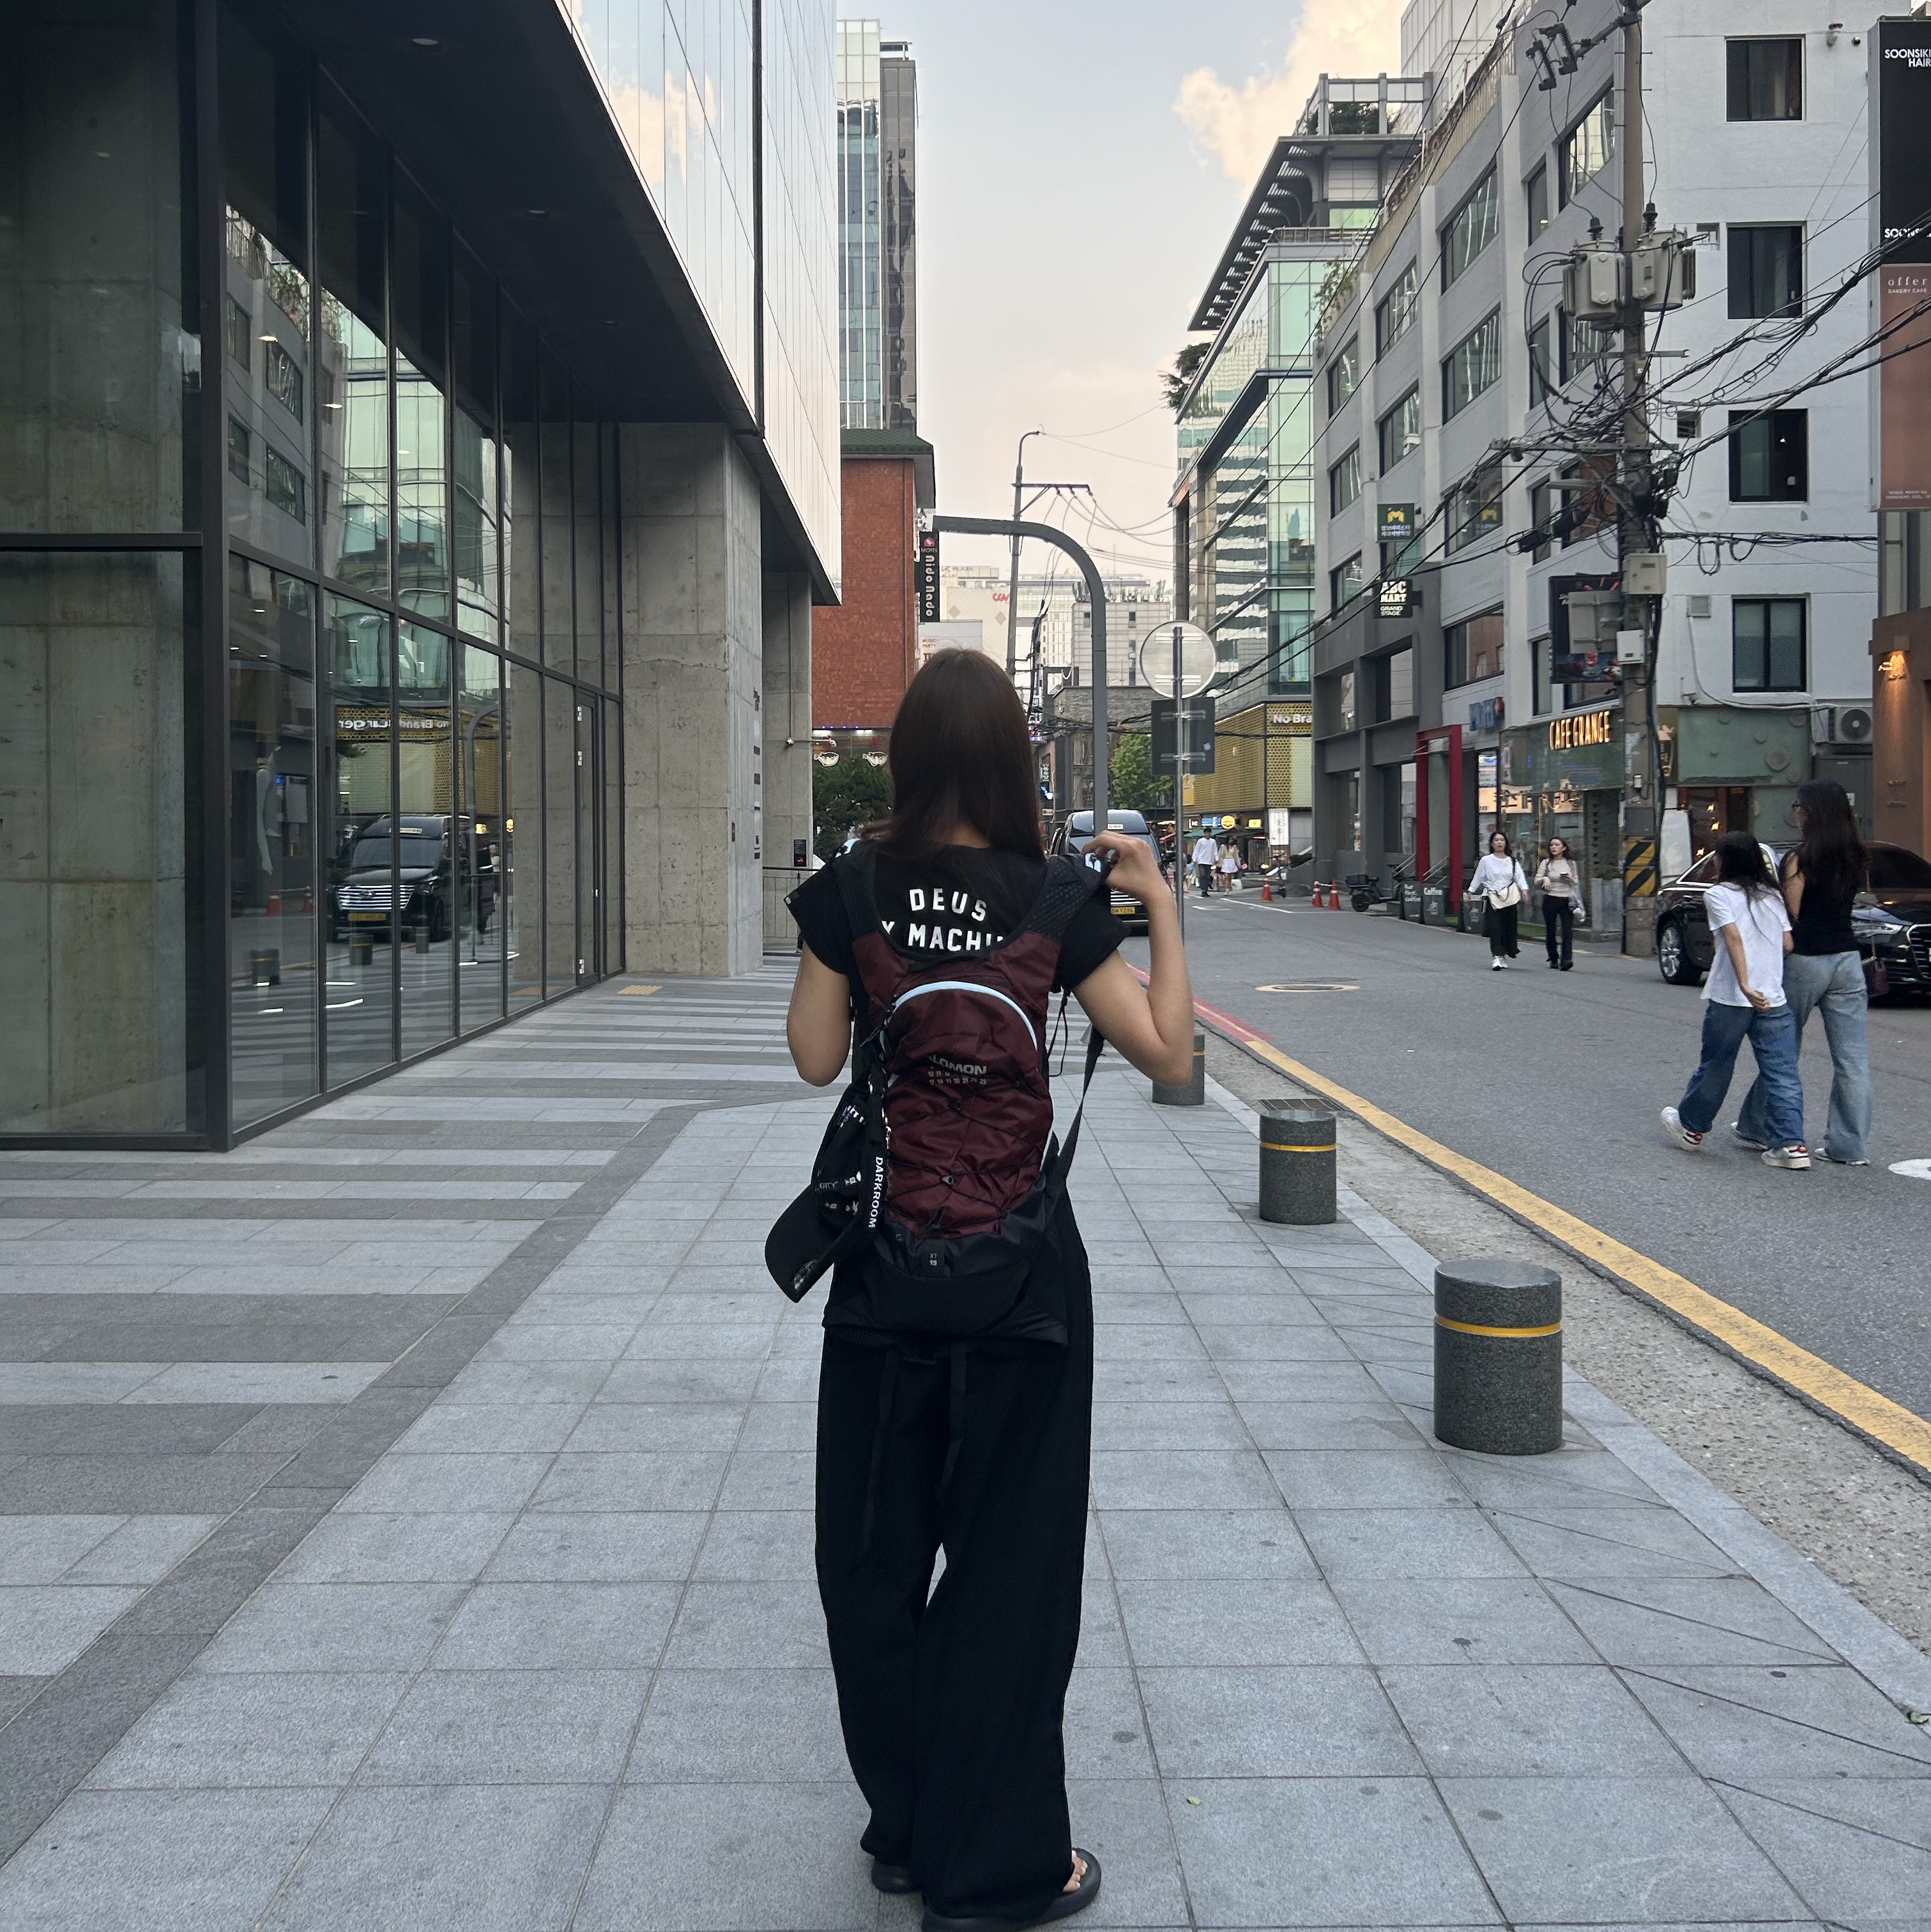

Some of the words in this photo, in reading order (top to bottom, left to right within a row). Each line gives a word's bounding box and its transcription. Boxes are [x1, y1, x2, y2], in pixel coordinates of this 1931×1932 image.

[1908, 58, 1931, 67] HAIR
[1888, 277, 1928, 286] offer
[925, 555, 935, 582] nido
[1380, 581, 1407, 594] ABC
[1380, 594, 1407, 602] MART
[925, 585, 935, 617] nado
[1273, 714, 1290, 724] No
[1292, 714, 1312, 724] Bra
[1549, 718, 1571, 750] CAFE
[1573, 710, 1610, 747] GRANGE
[909, 888, 987, 922] DEUS
[908, 923, 1004, 952] MACHI
[928, 1054, 987, 1075] LOMON
[868, 1156, 883, 1228] DARKROOM
